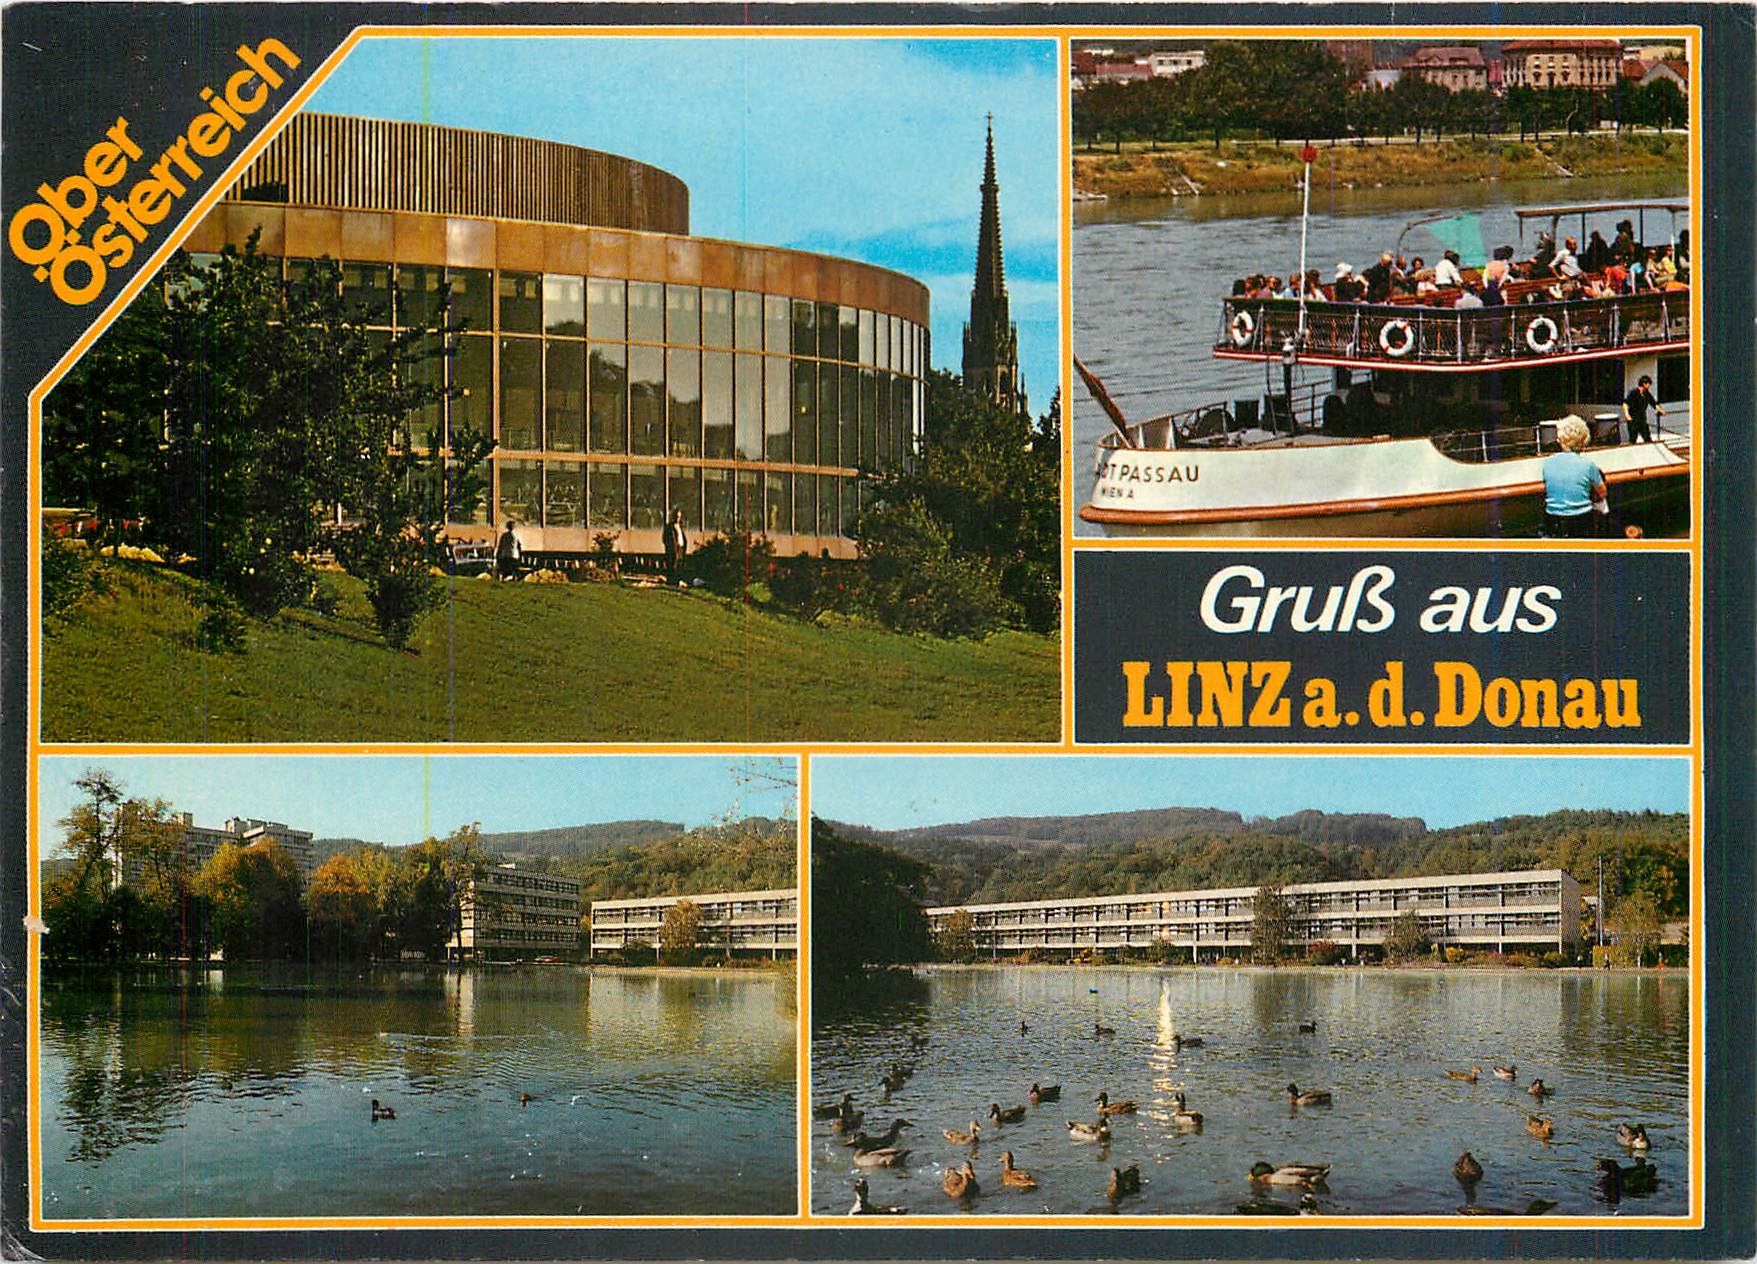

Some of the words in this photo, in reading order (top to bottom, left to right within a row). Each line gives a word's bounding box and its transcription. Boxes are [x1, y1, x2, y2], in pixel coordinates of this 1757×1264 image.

[8, 116, 144, 265] Ober
[33, 37, 302, 305] Österreich
[1119, 464, 1199, 483] PASSAU
[1200, 565, 1395, 633] Gruß
[1419, 585, 1562, 633] aus
[1122, 661, 1291, 727] LINZ
[1303, 678, 1359, 728] a.
[1368, 661, 1425, 727] d.
[1434, 661, 1641, 728] Donau
